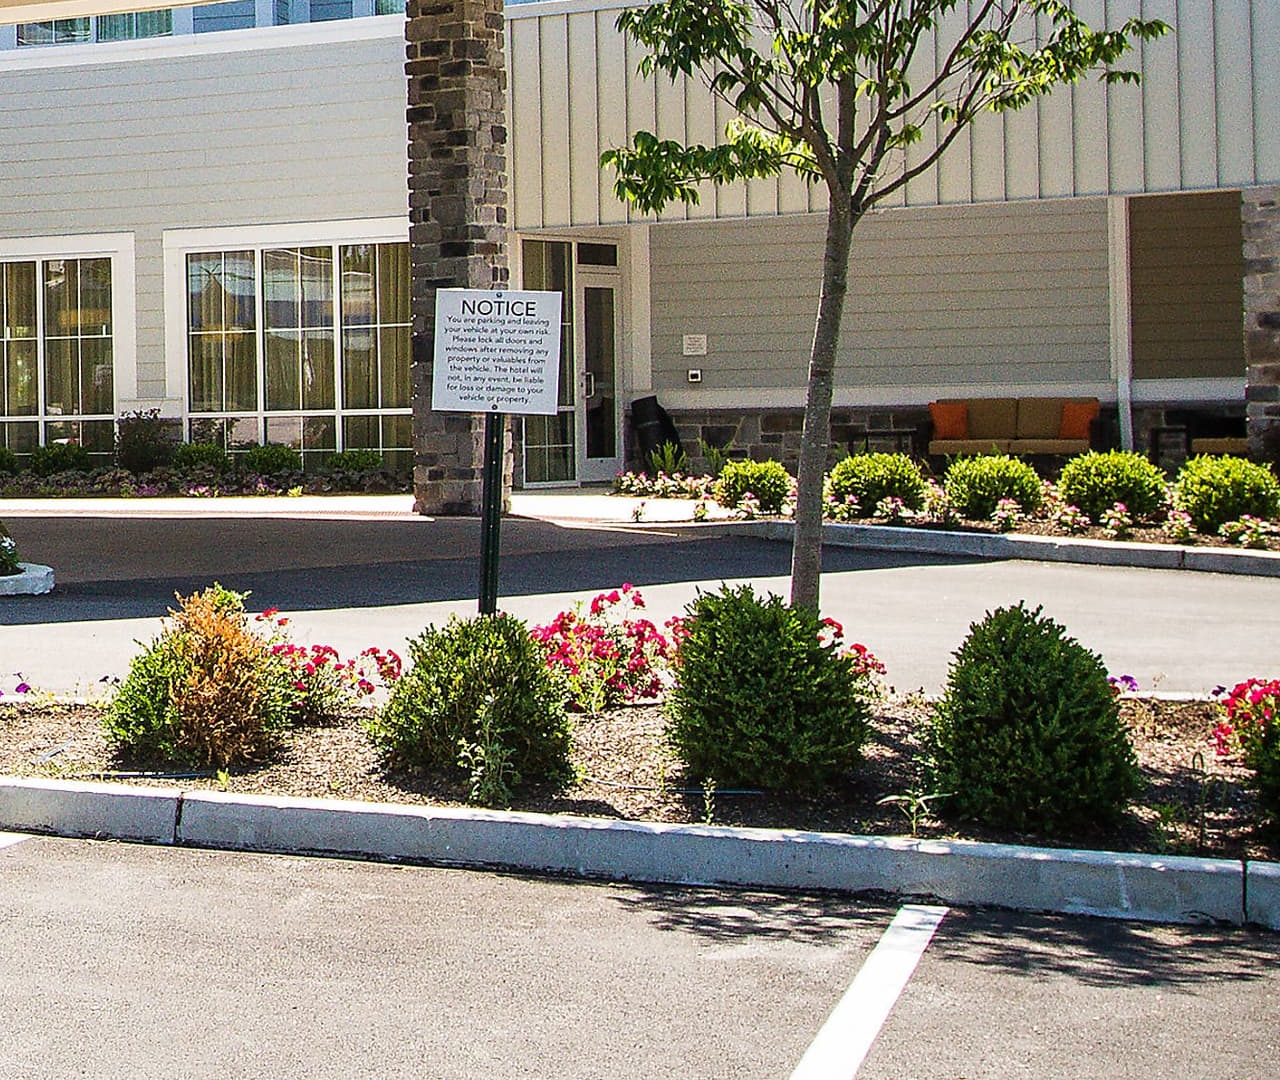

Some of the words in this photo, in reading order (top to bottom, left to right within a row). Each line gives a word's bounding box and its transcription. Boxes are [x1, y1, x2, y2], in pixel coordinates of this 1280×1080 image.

[462, 300, 536, 317] NOTICE
[446, 315, 462, 323] You
[477, 317, 506, 326] parking
[522, 317, 550, 327] leaving
[463, 326, 489, 334] vehicle
[500, 328, 517, 336] your
[452, 335, 477, 343] Please
[505, 337, 527, 345] doors
[528, 337, 543, 345] and
[445, 345, 478, 353] windows
[498, 347, 534, 356] removing
[535, 349, 549, 357] any
[447, 356, 481, 364] property
[492, 356, 526, 364] valuables
[527, 356, 545, 364] from
[473, 376, 486, 384] any
[524, 376, 544, 384] liable
[447, 383, 458, 391] for
[459, 383, 474, 391] loss
[485, 384, 516, 394] damage
[459, 393, 485, 401] vehicle
